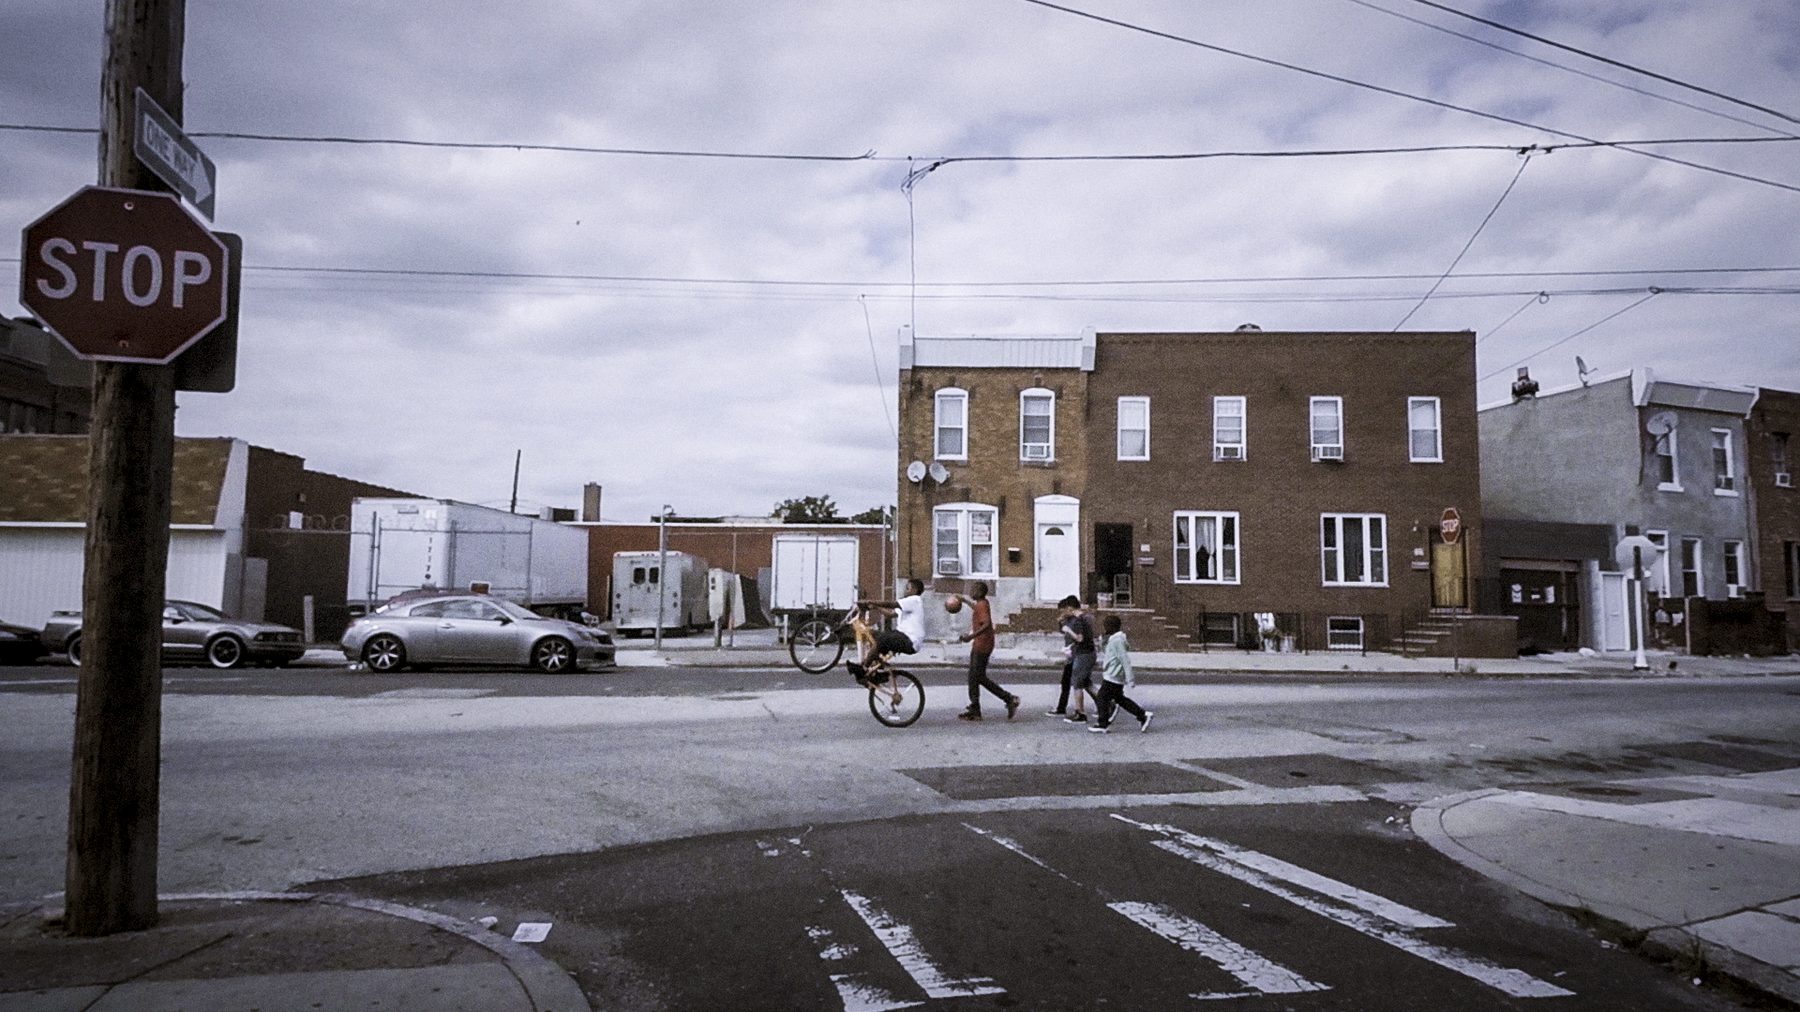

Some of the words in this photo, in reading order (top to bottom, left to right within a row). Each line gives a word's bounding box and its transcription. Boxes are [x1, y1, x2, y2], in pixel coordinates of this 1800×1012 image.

[146, 119, 170, 162] ONE
[173, 143, 196, 180] WAY
[37, 238, 211, 308] STOP
[1442, 519, 1459, 532] STOP
